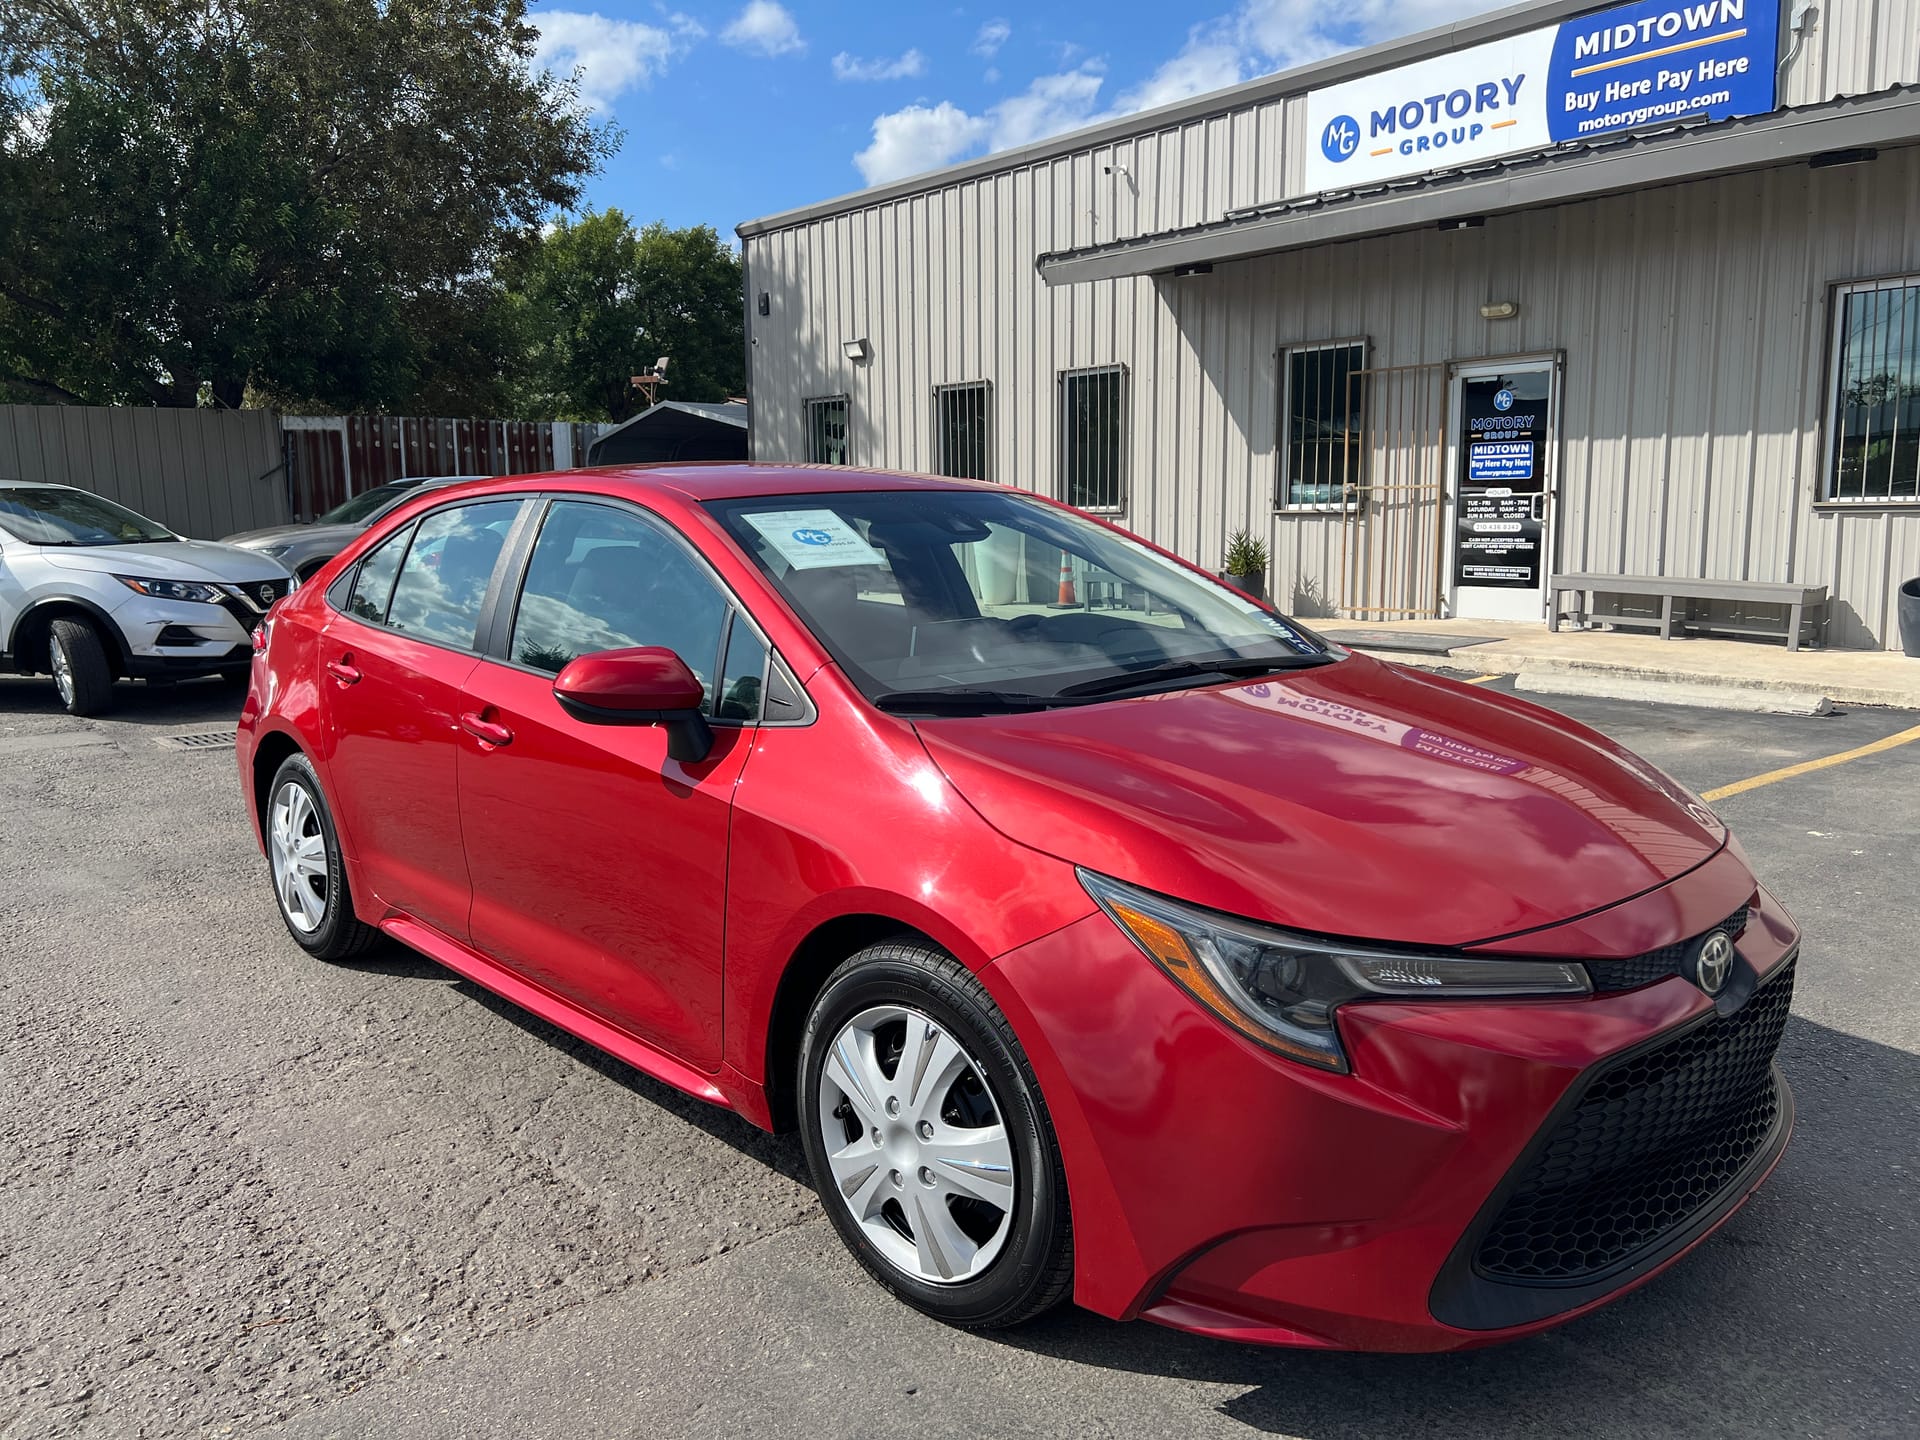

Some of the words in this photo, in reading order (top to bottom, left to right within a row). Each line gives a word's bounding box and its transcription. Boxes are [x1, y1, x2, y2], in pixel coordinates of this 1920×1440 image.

[1574, 0, 1744, 60] MIDTOWN
[1565, 90, 1600, 112] Buy
[1605, 79, 1652, 103] Here
[1657, 68, 1693, 91] Pay
[1698, 56, 1749, 82] Here
[1370, 74, 1526, 138] MOTORY
[1578, 89, 1730, 133] motorygroup.com
[1399, 123, 1484, 155] GROUP
[1470, 415, 1535, 431] MOTORY
[1483, 430, 1519, 440] GROUP
[1471, 460, 1484, 470] Buy
[1485, 459, 1501, 468] Here
[1502, 459, 1514, 469] Pay
[1514, 458, 1531, 467] Here
[1474, 444, 1529, 455] MIDTOWN
